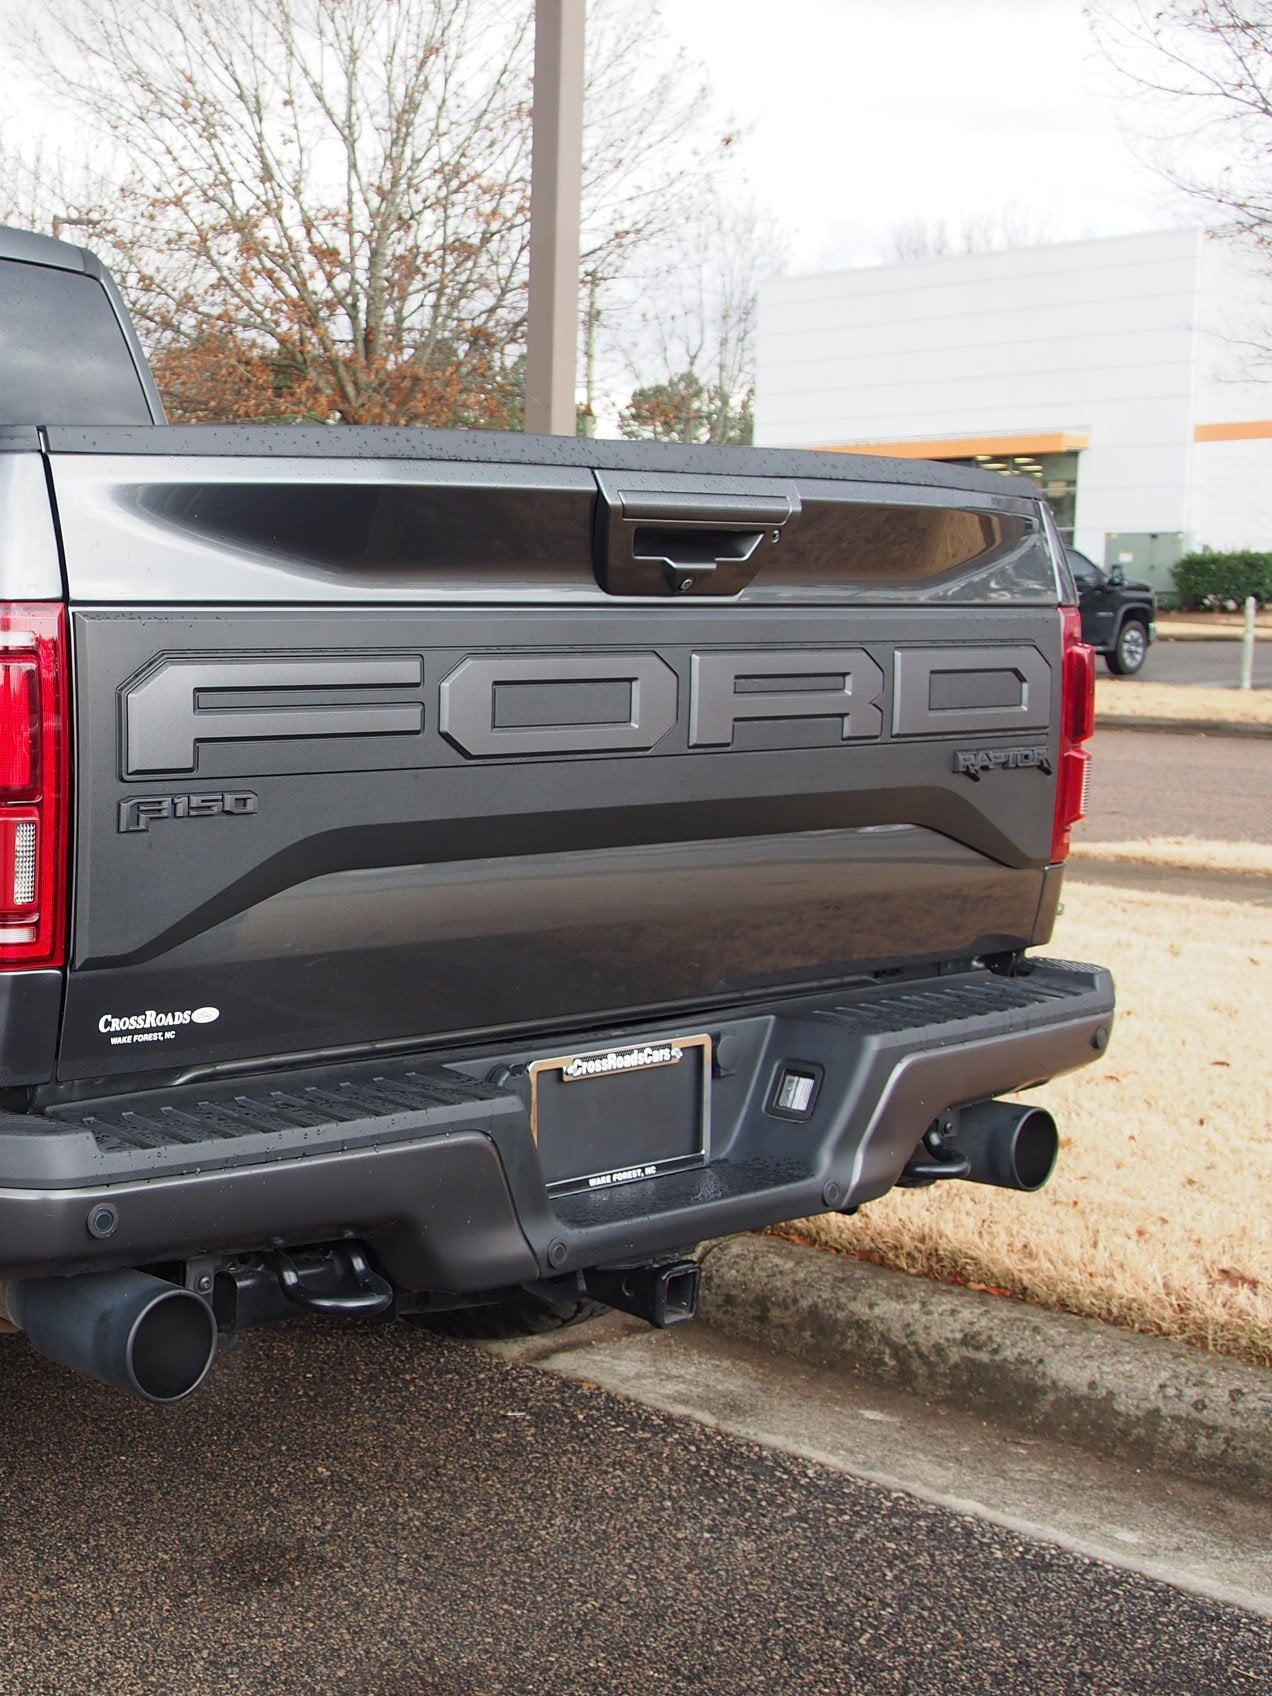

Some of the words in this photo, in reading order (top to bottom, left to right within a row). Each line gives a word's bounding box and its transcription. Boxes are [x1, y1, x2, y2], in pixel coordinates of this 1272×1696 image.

[124, 645, 1053, 776] FORD
[953, 746, 1052, 781] RAPTOR
[118, 790, 258, 833] F150
[110, 1035, 132, 1045] WAKE
[133, 1032, 163, 1042] FOREST,
[164, 1031, 175, 1039] NC
[572, 1047, 671, 1077] CrossRoadsCars
[588, 1175, 611, 1187] WAKE
[644, 1165, 656, 1175] NC
